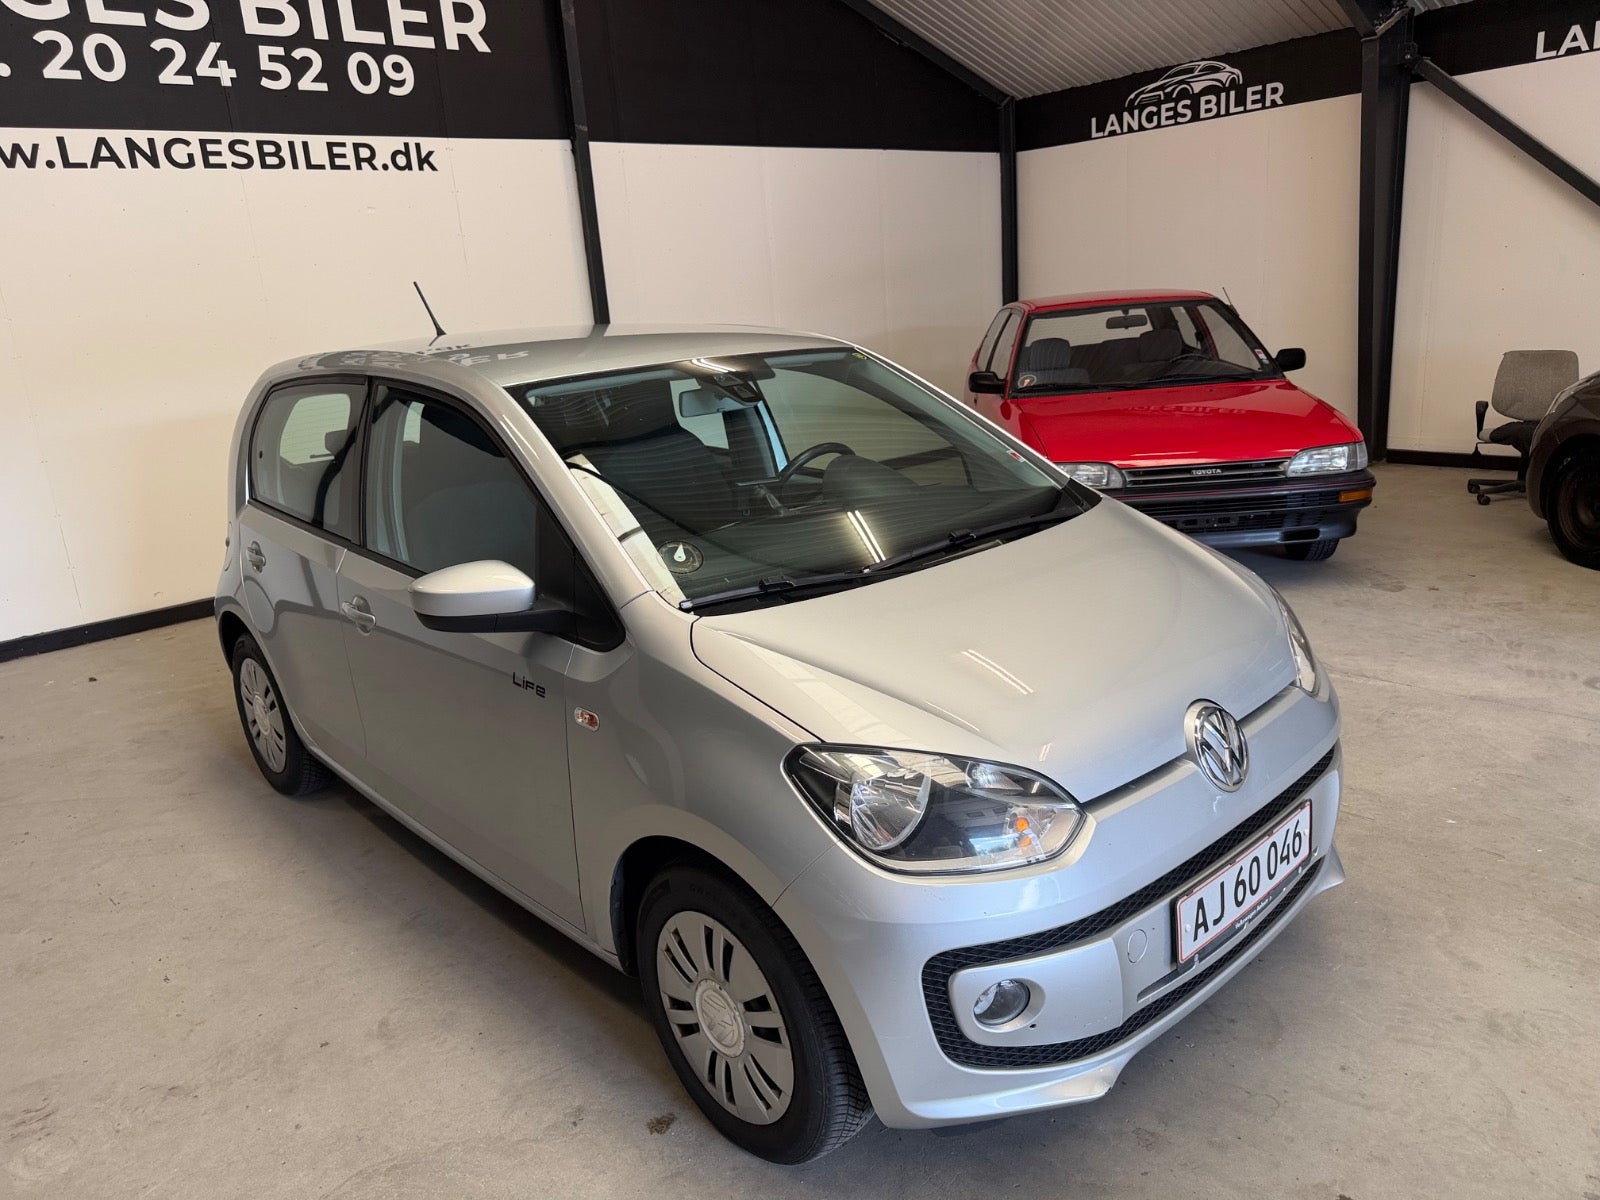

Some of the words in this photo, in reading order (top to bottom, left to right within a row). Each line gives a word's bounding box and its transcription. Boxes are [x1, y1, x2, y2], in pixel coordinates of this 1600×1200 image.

[33, 29, 127, 82] 20
[150, 38, 237, 87] 24
[258, 45, 329, 92] 52
[347, 51, 415, 96] 09
[1535, 20, 1600, 60] LA
[1090, 99, 1193, 139] LANGES
[1199, 82, 1285, 119] BILER
[1193, 881, 1225, 942] AJ
[1233, 855, 1261, 908] 60
[1266, 819, 1302, 880] 046
